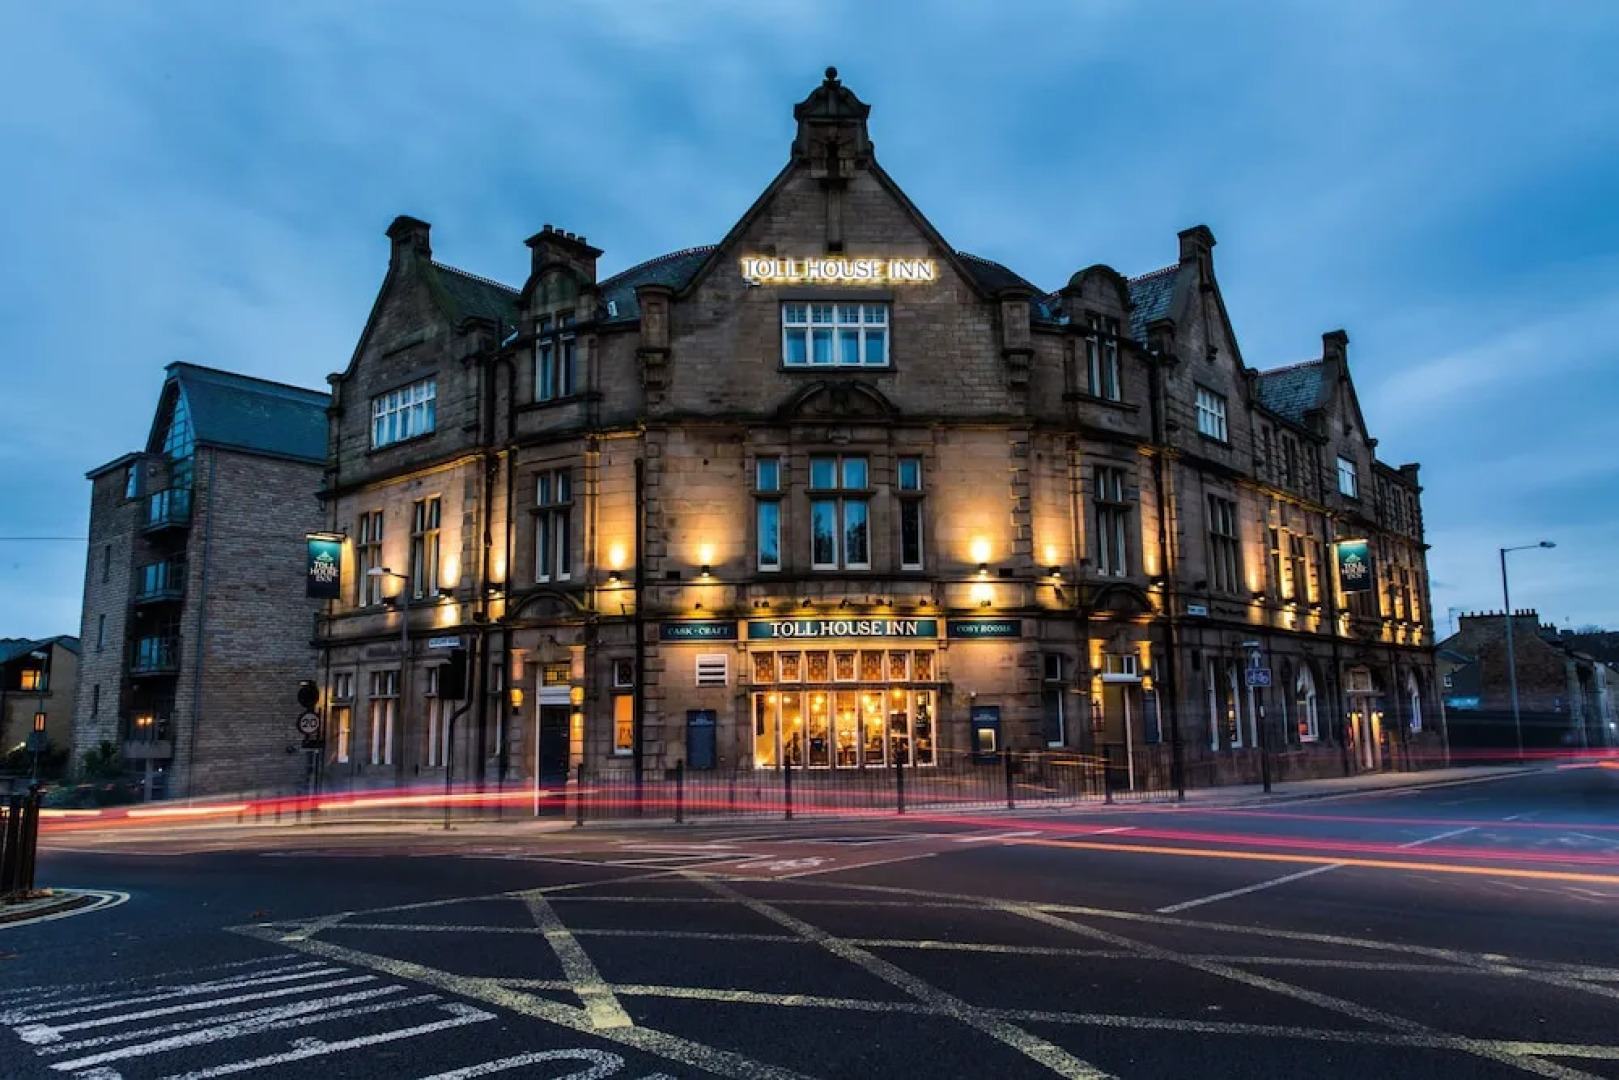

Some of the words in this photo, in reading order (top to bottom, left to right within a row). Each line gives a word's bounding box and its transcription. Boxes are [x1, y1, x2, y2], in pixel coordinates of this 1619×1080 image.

[743, 258, 801, 278] TOLL
[806, 258, 883, 278] HOUSE
[890, 258, 935, 280] INN
[668, 626, 693, 636] CASK
[699, 626, 729, 636] CRAFT
[770, 620, 818, 637] TOLL
[820, 620, 882, 637] HOUSE
[885, 620, 919, 637] INN
[302, 718, 318, 728] 20
